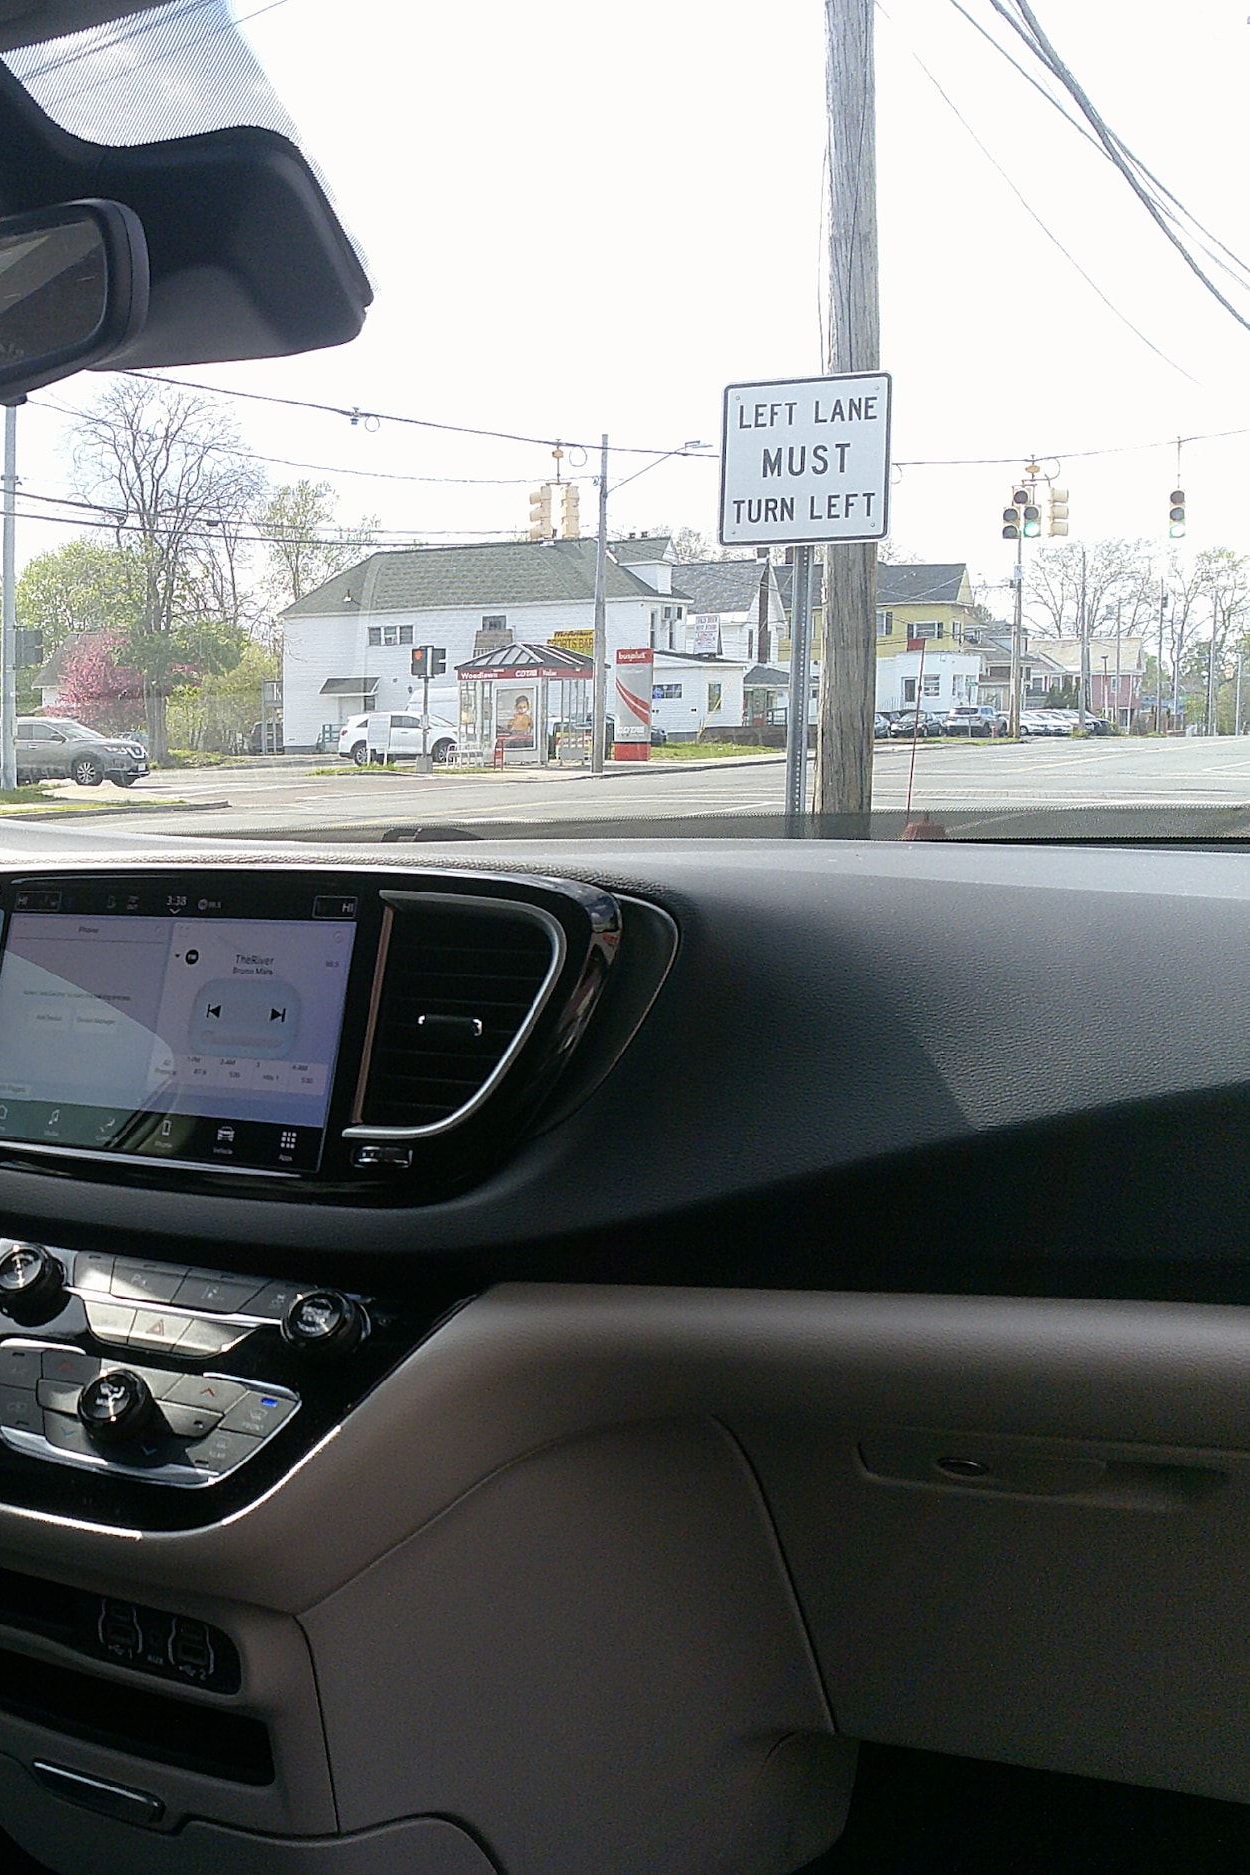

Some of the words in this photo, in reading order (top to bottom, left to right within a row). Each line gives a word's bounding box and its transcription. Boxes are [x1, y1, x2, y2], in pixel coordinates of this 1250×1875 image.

[739, 402, 797, 429] LEFT
[814, 397, 878, 423] LANE
[762, 443, 851, 478] MUST
[732, 497, 795, 524] TURN
[809, 493, 876, 520] LEFT
[166, 895, 187, 906] 3:38
[342, 903, 354, 912] HI
[235, 954, 275, 966] TheRiver
